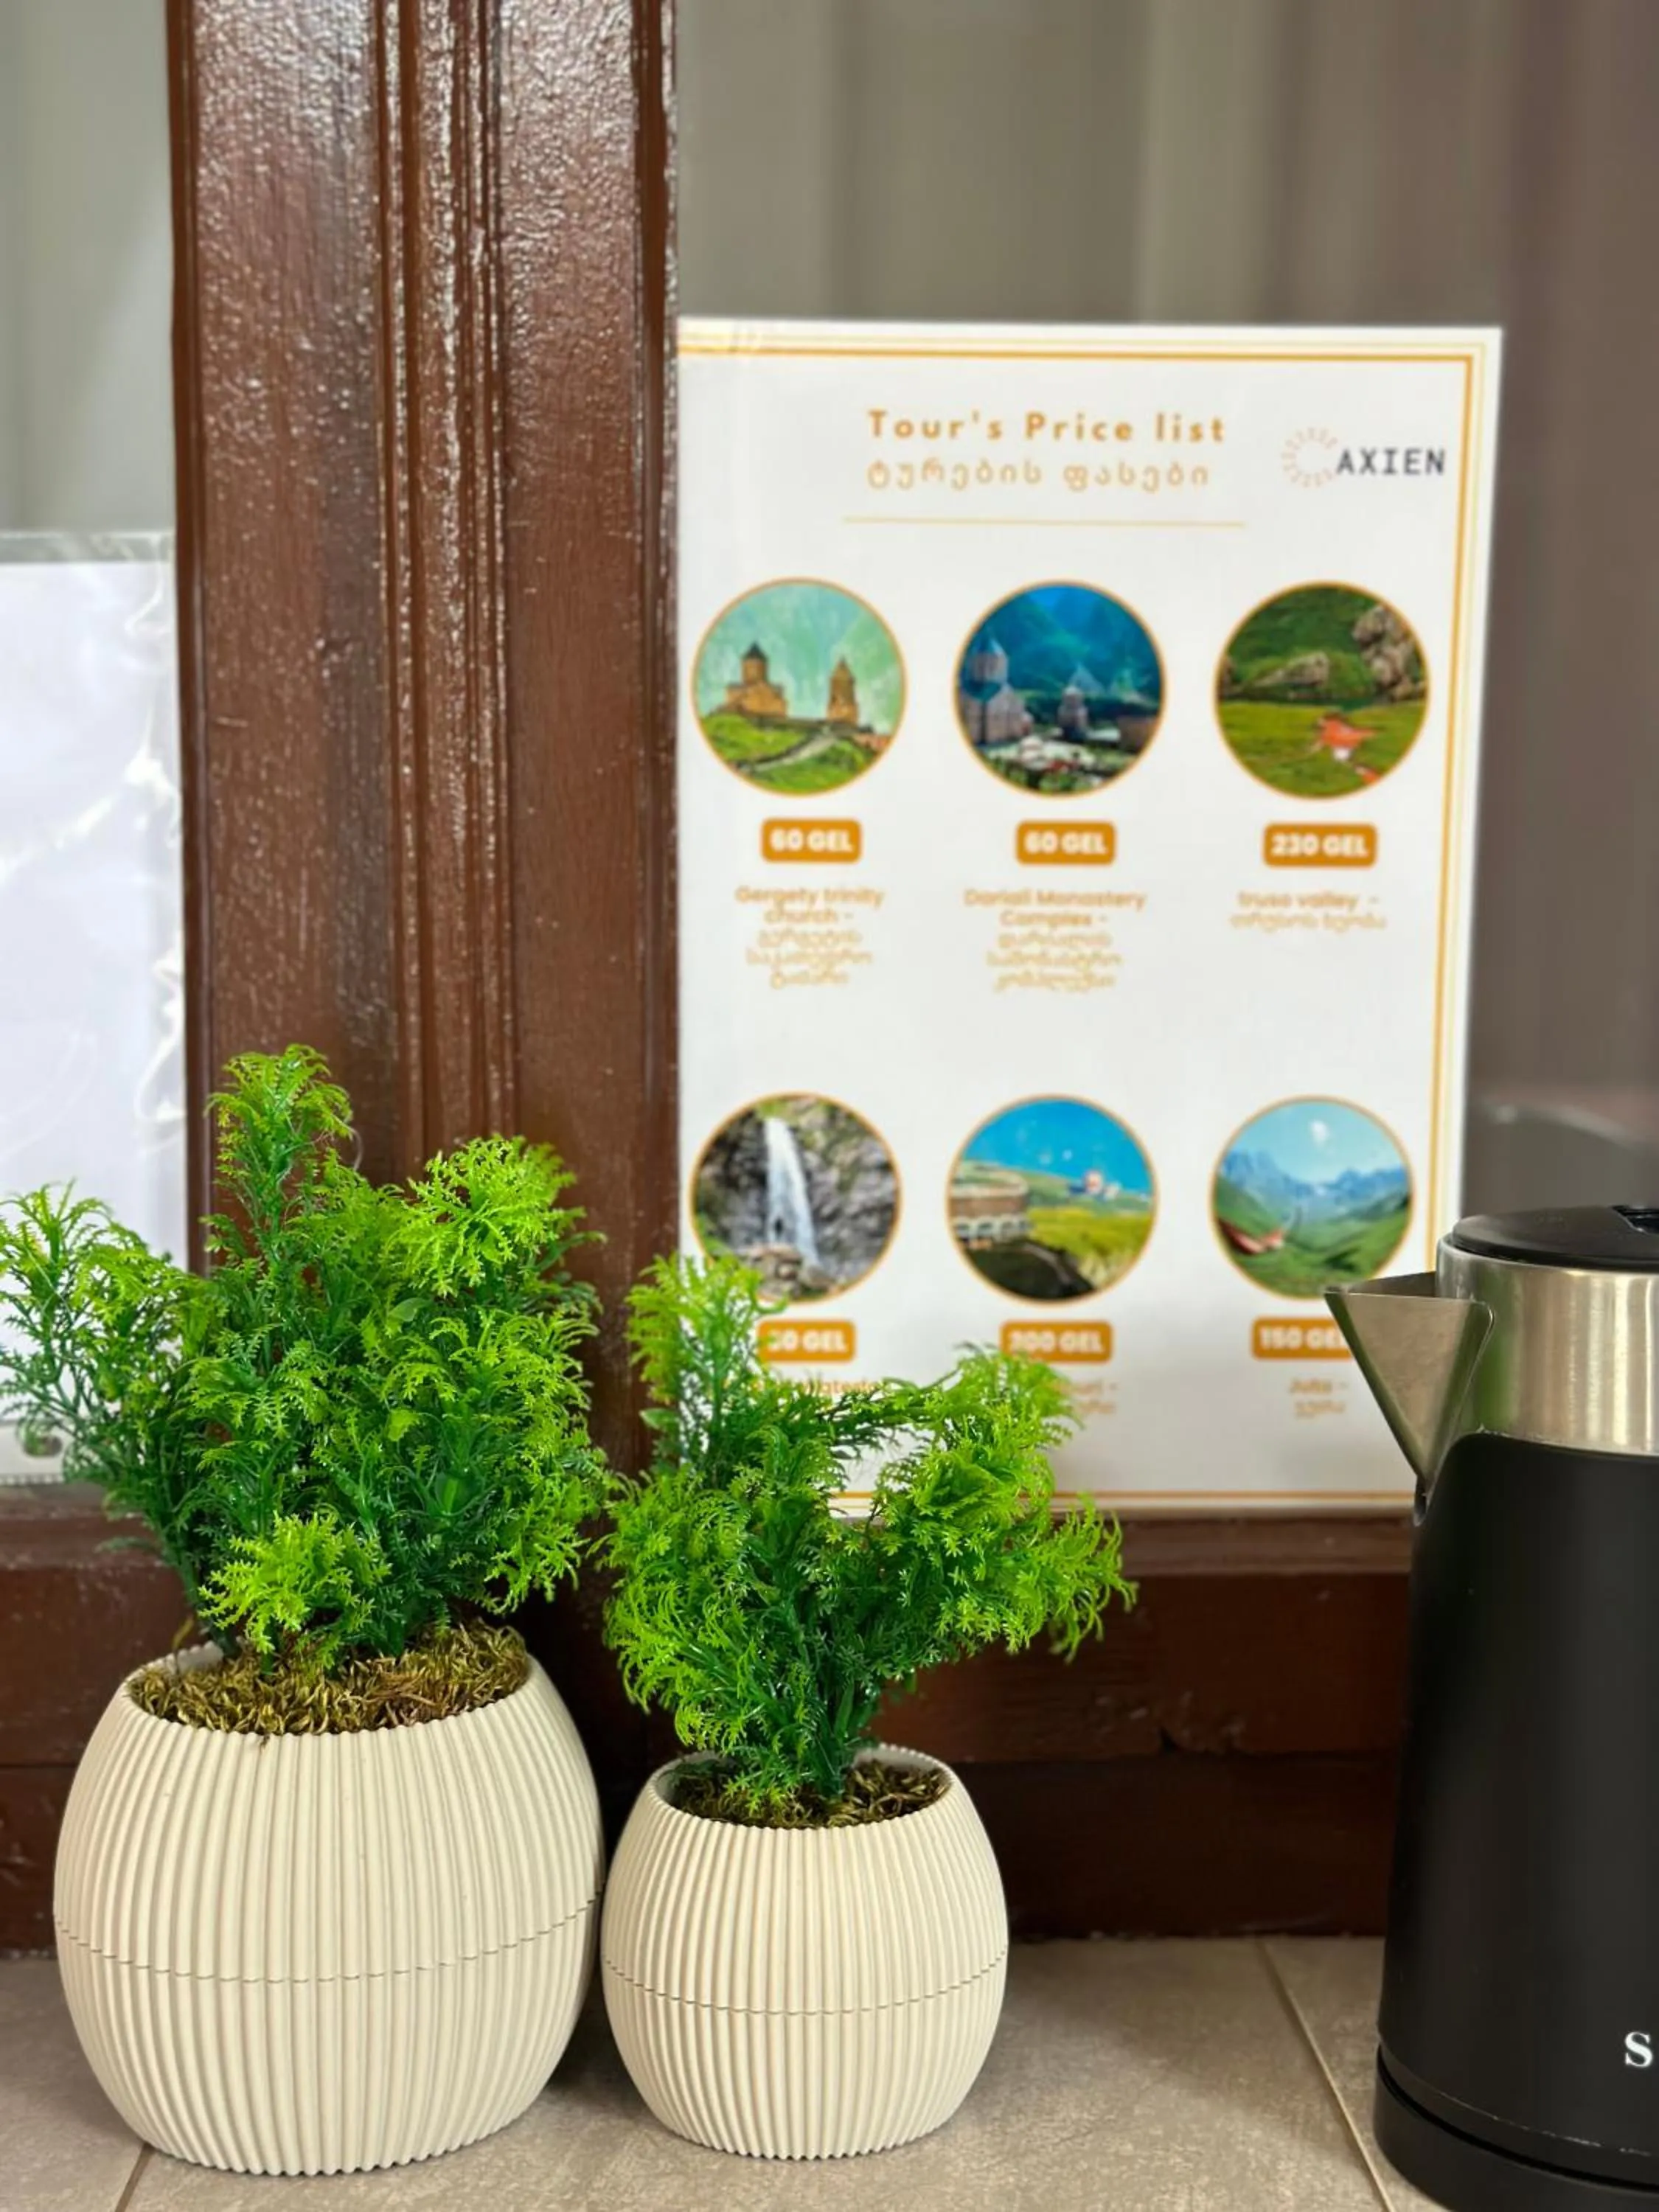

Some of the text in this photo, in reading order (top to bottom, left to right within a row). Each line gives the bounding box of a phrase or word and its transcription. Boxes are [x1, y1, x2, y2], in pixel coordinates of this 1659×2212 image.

[868, 408, 1224, 443] Tour's Price list
[867, 456, 1208, 493] ტურების ფასები
[1336, 448, 1445, 476] AXIEN
[770, 827, 853, 852] 60 GEL
[1024, 830, 1107, 855] 60 GEL
[1271, 832, 1369, 858] 230 GEL
[803, 1329, 847, 1352] GEL
[1060, 1330, 1105, 1354] GEL
